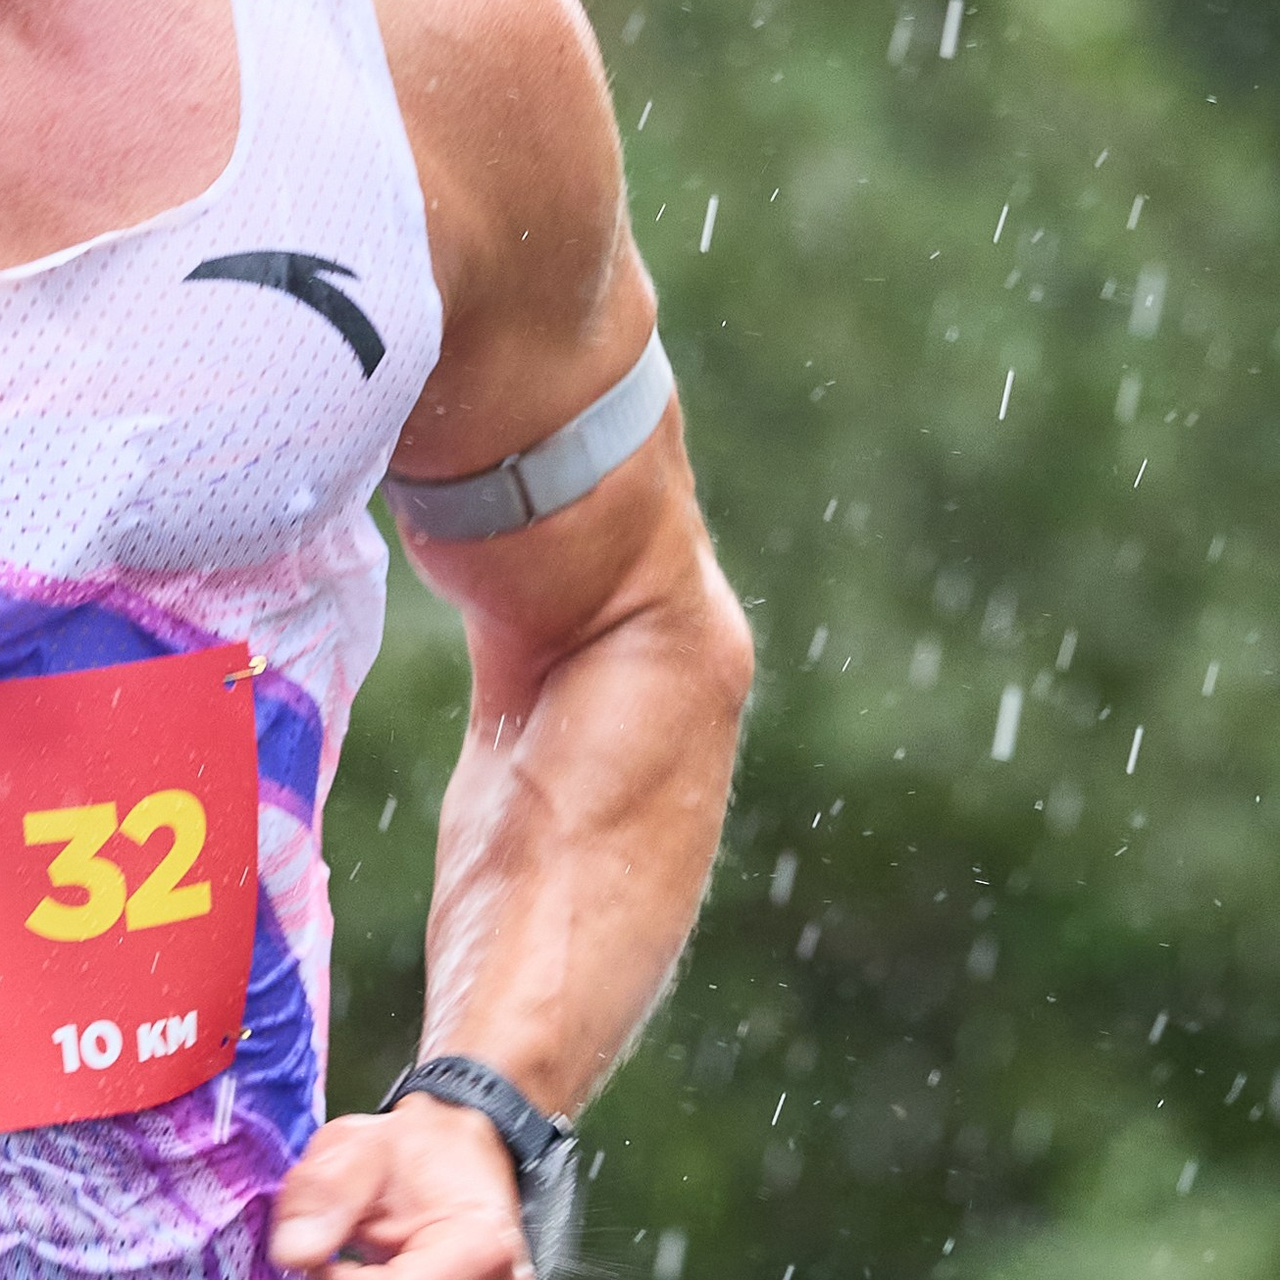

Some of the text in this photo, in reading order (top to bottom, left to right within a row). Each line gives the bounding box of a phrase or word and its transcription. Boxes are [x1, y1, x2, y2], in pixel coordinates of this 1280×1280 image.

[23, 788, 213, 942] 32
[52, 1010, 200, 1074] 10 КМ
